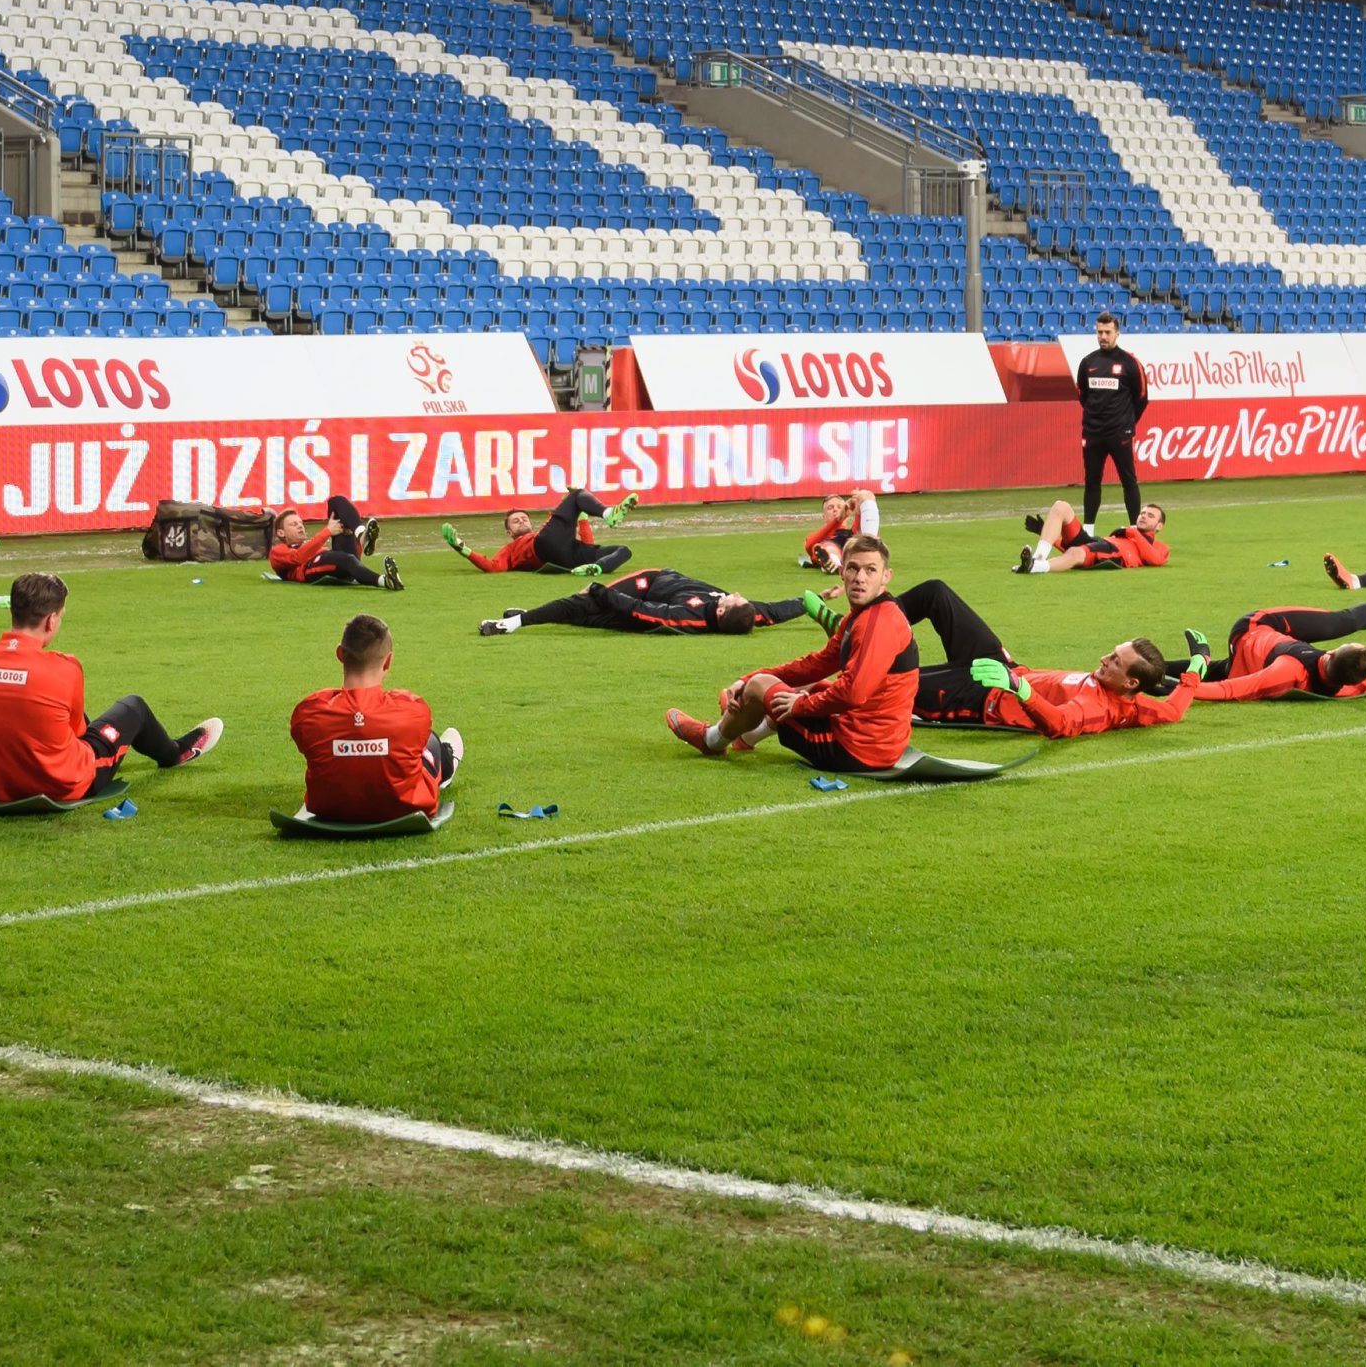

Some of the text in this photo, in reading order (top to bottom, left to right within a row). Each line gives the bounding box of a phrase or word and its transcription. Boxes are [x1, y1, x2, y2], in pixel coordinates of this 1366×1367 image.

[12, 358, 171, 410] LOTOS
[584, 373, 598, 394] M
[780, 351, 894, 399] LOTOS
[1146, 349, 1306, 397] aczyNasPilka.pl
[421, 399, 468, 414] POLSKA
[1, 422, 151, 517] JUŻ
[171, 418, 332, 507] DZIŚ
[351, 433, 369, 503] I
[388, 420, 805, 502] ZAREJESTRUJ
[816, 417, 909, 493] SIĘ!
[350, 742, 384, 753] LOTOS
